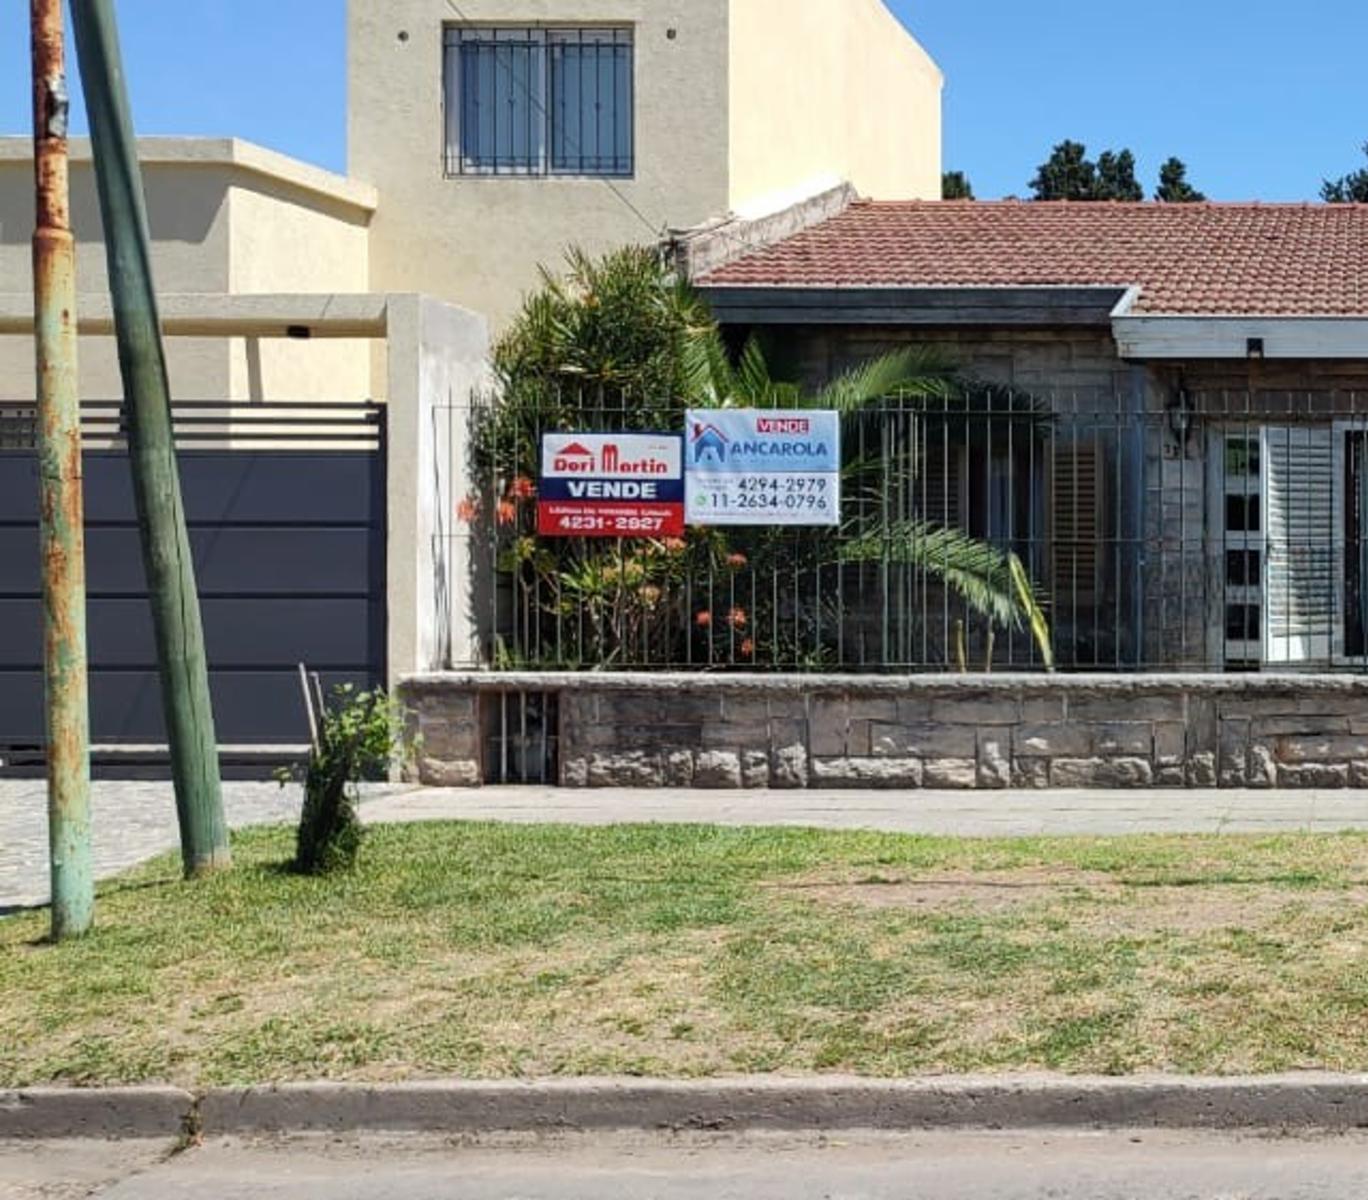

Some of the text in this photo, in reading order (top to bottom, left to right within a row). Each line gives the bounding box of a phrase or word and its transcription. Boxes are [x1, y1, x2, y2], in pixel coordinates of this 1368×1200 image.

[758, 419, 809, 433] VENDE
[731, 442, 828, 456] ANCAROLA
[567, 481, 658, 499] VENDE
[738, 478, 827, 492] 4294-2979
[711, 493, 827, 508] 11-2634-0796
